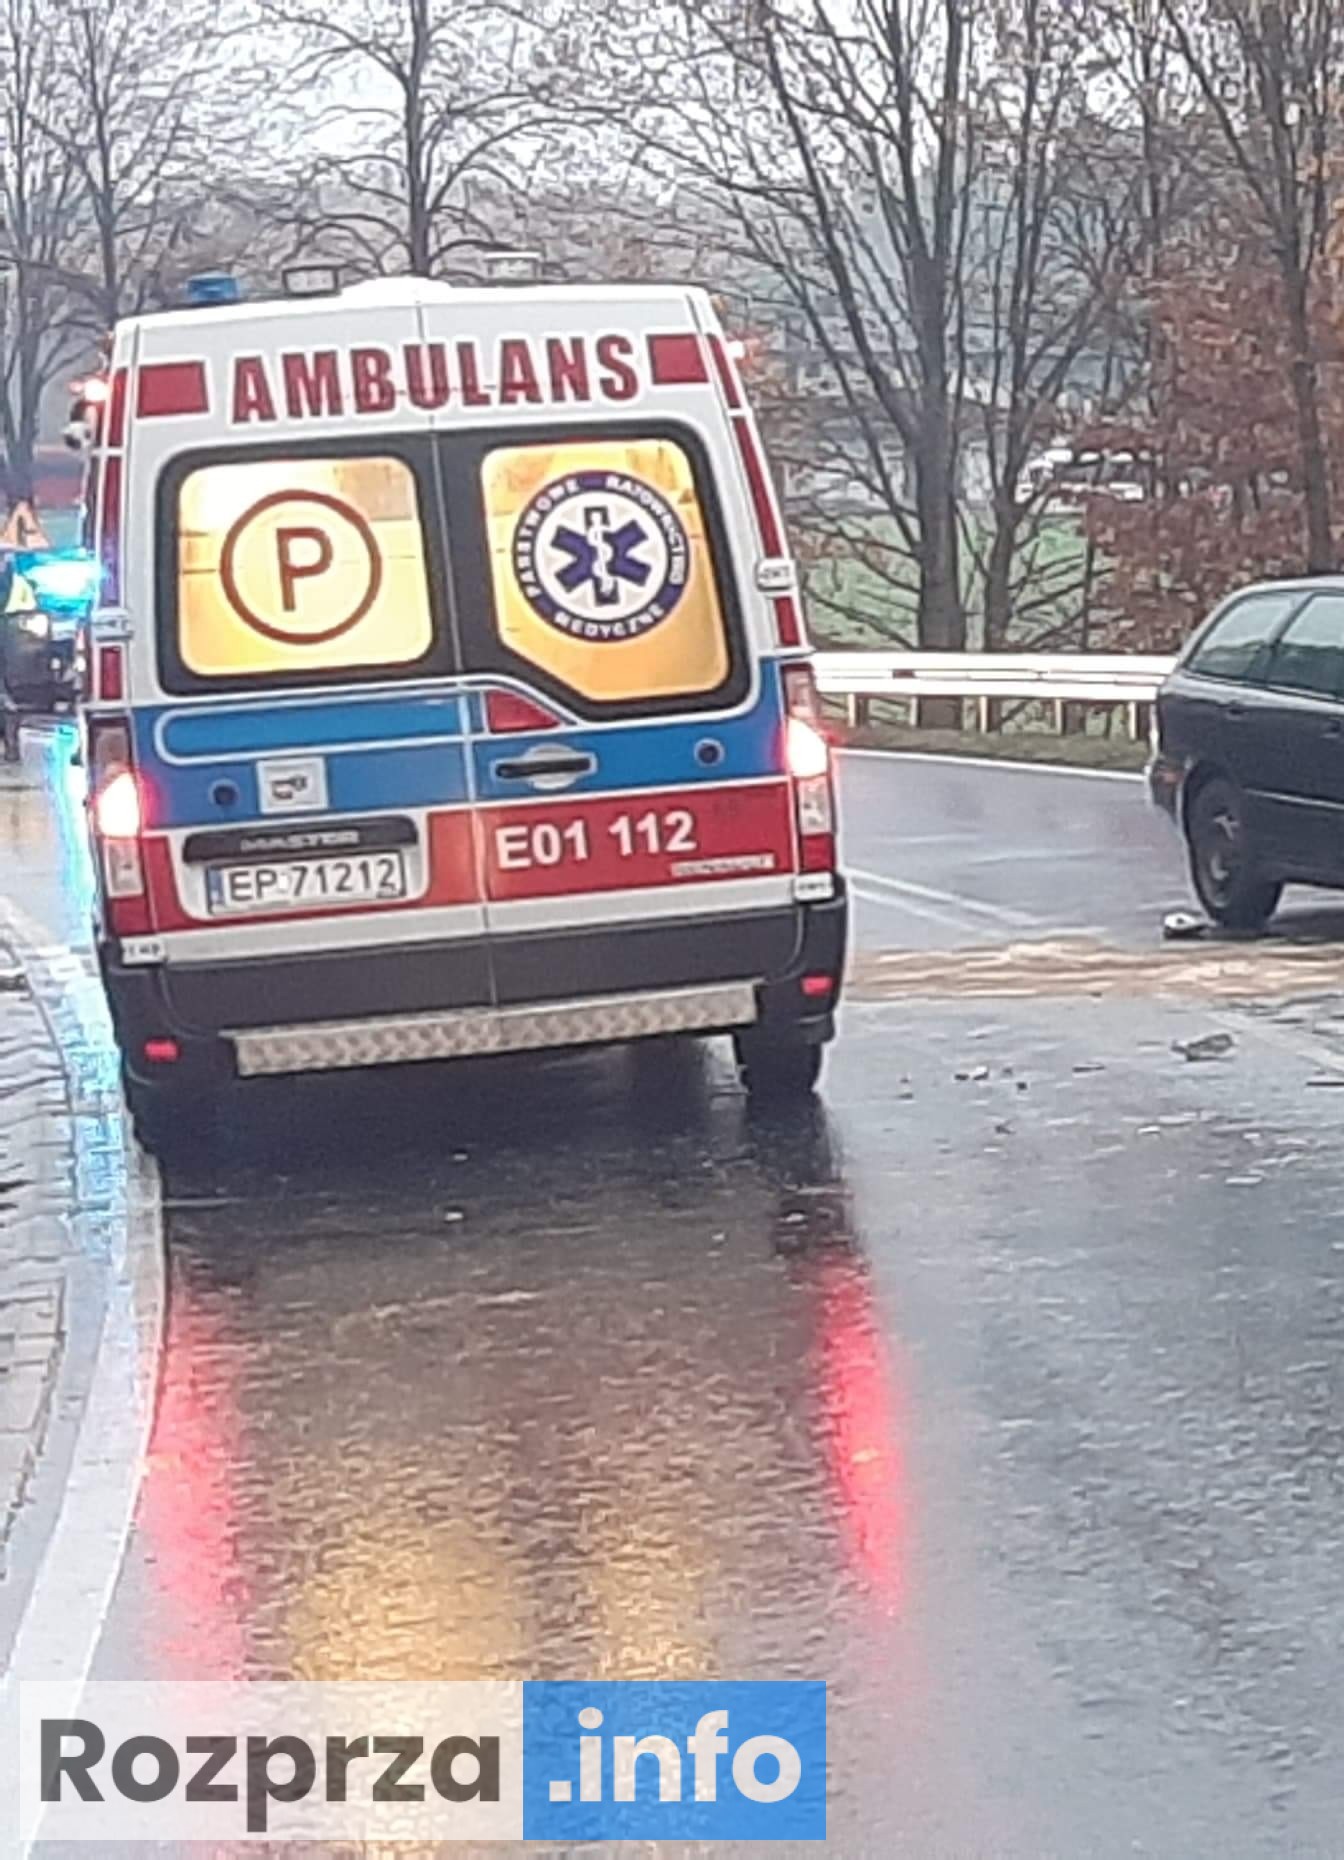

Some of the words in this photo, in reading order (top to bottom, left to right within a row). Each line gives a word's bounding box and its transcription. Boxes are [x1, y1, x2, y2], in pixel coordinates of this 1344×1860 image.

[231, 334, 639, 424] AMBULANS
[276, 527, 334, 612] P
[240, 829, 360, 851] MASTER
[494, 819, 589, 870] E01
[607, 810, 698, 856] 112
[228, 867, 278, 901] EP
[291, 858, 396, 897] 71212
